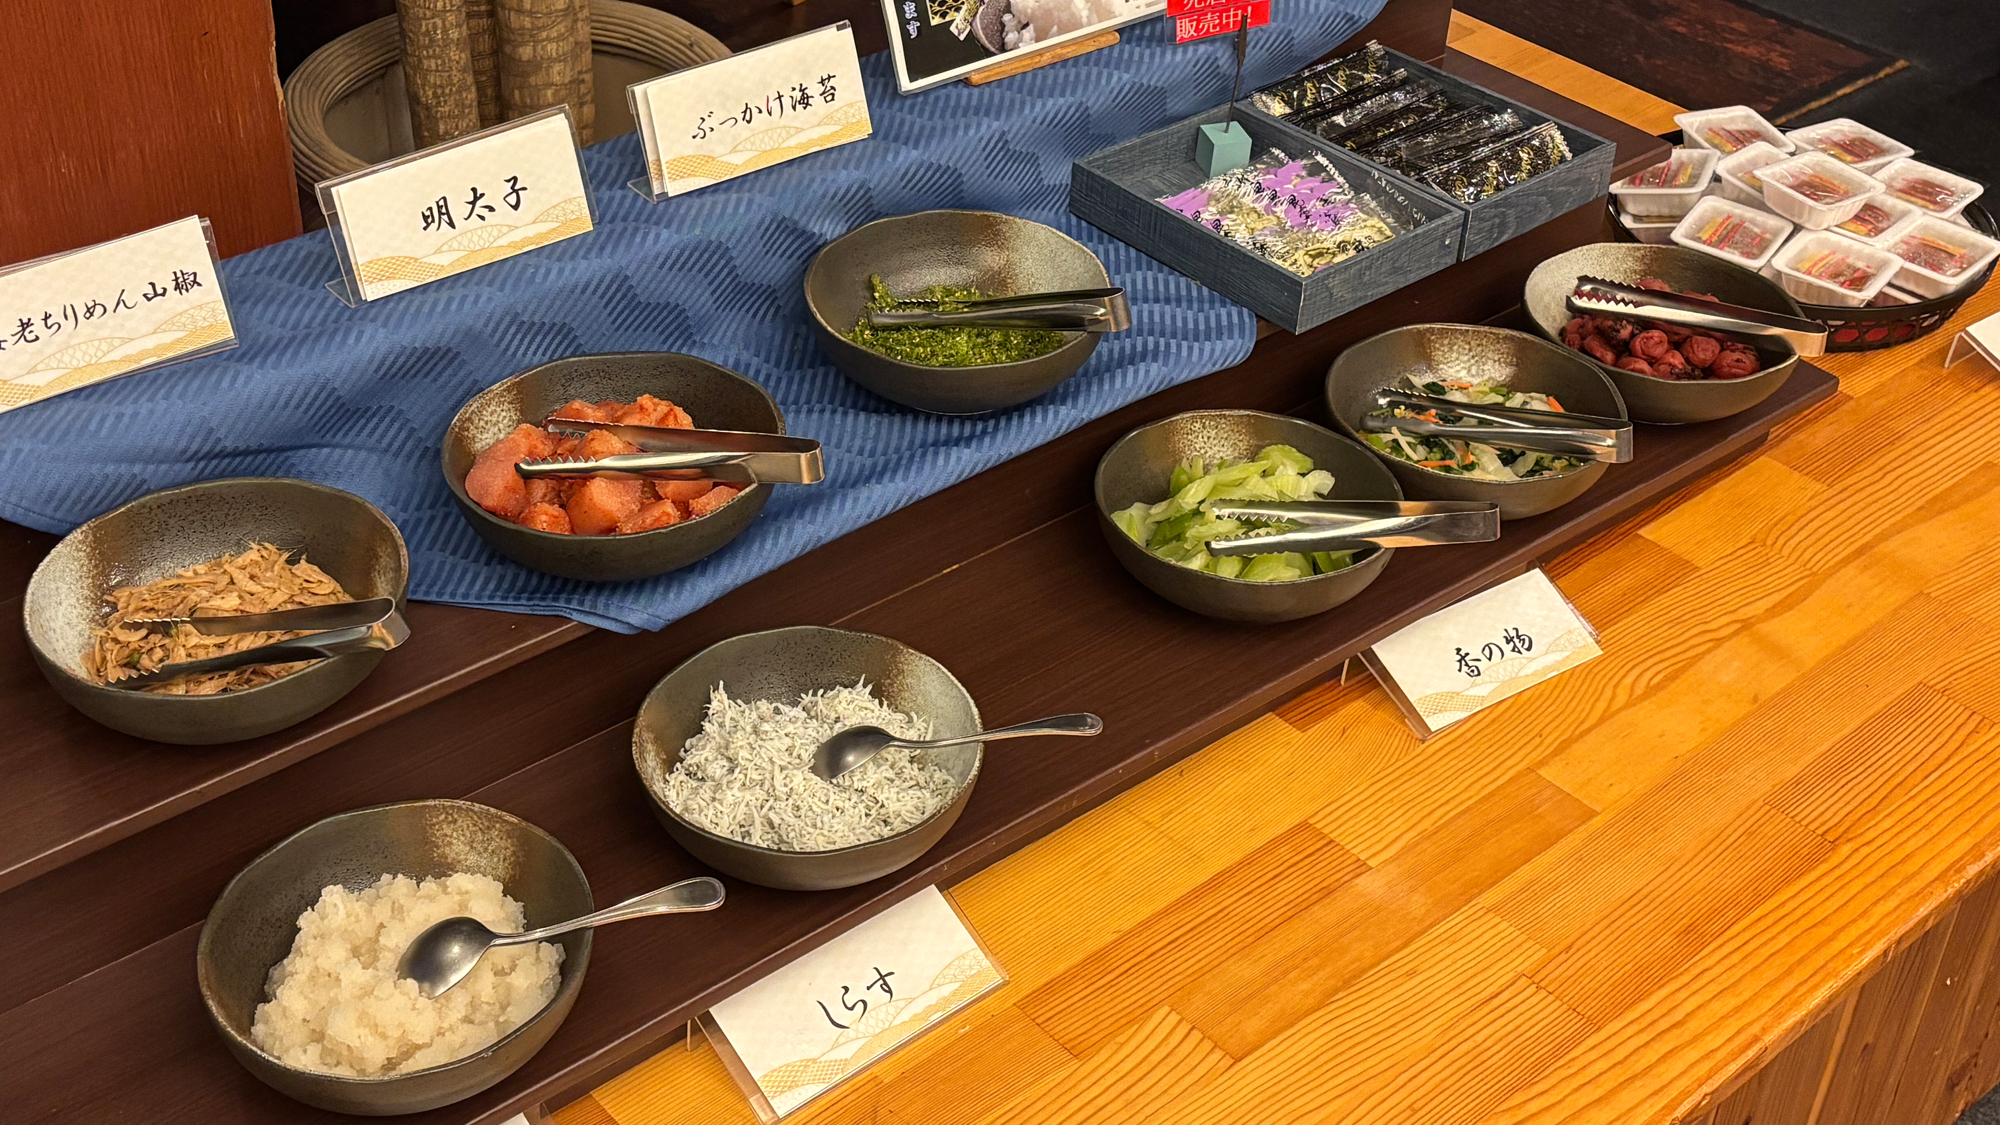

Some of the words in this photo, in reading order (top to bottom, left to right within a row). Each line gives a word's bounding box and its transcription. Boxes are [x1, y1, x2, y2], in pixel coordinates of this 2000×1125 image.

[903, 1, 920, 39] ます
[1177, 5, 1252, 39] 販売中!
[691, 73, 837, 140] ぶっかけ海苔
[420, 175, 528, 232] 明太子
[0, 269, 203, 351] 老ちりめん山椒
[1454, 627, 1533, 678] 香の物
[816, 966, 895, 1029] しらす
